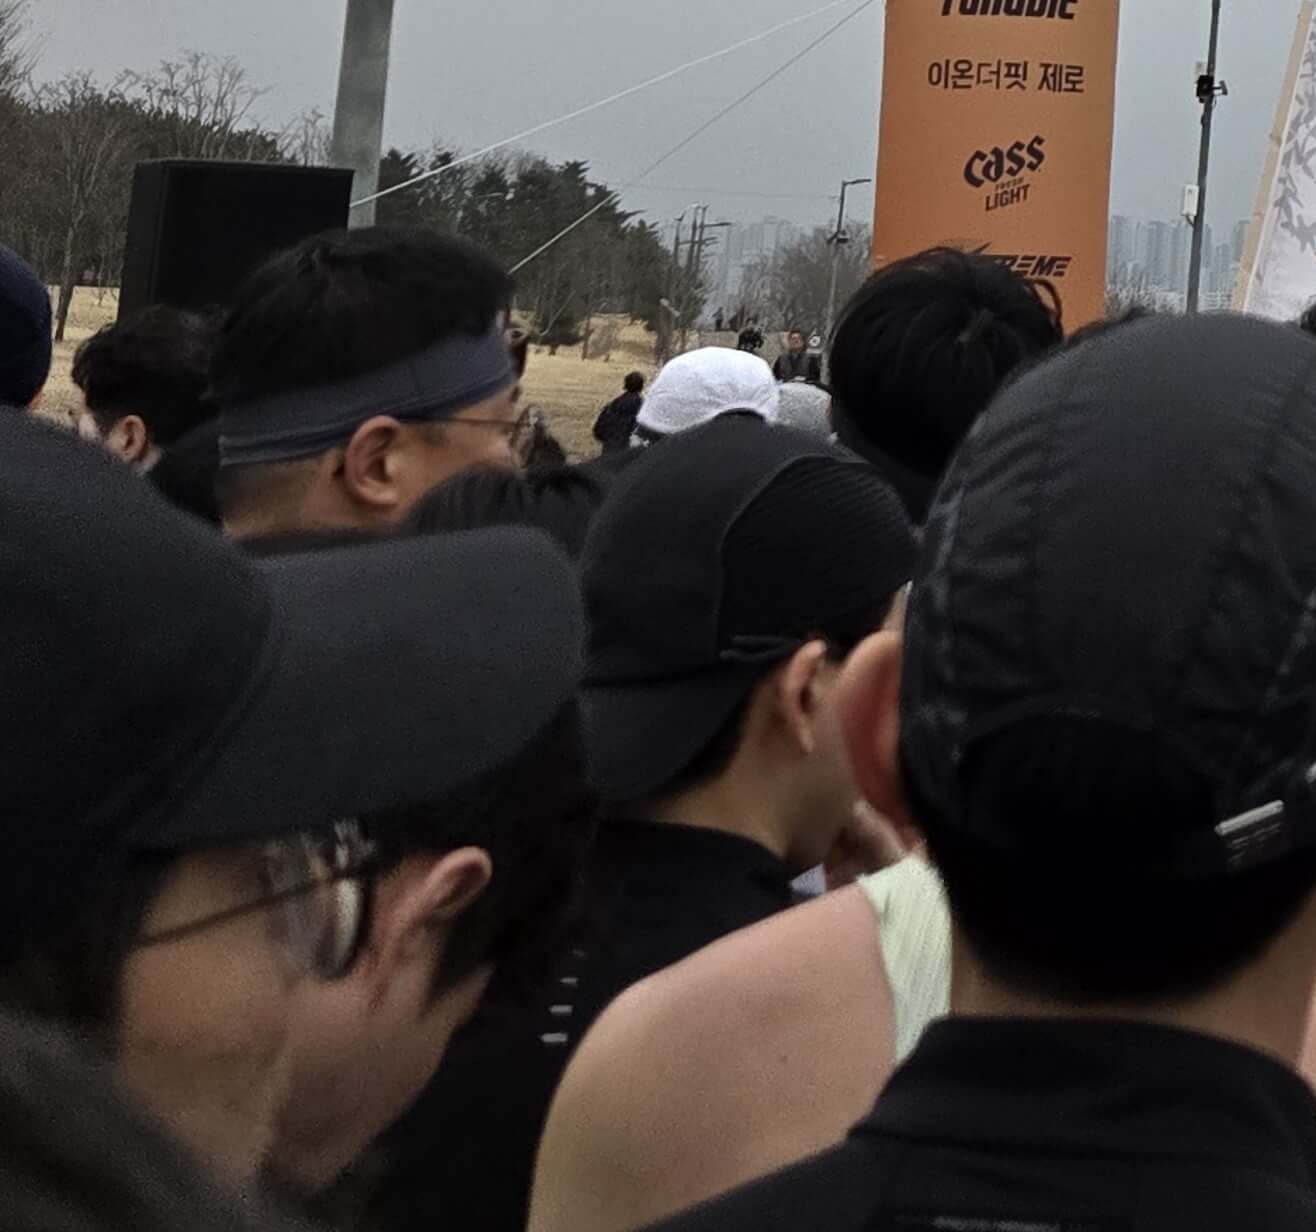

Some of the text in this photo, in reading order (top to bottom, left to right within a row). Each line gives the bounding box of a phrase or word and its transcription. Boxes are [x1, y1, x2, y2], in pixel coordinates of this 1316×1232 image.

[927, 58, 1085, 94] 이온더핏 제로
[985, 184, 1031, 212] LIGHT
